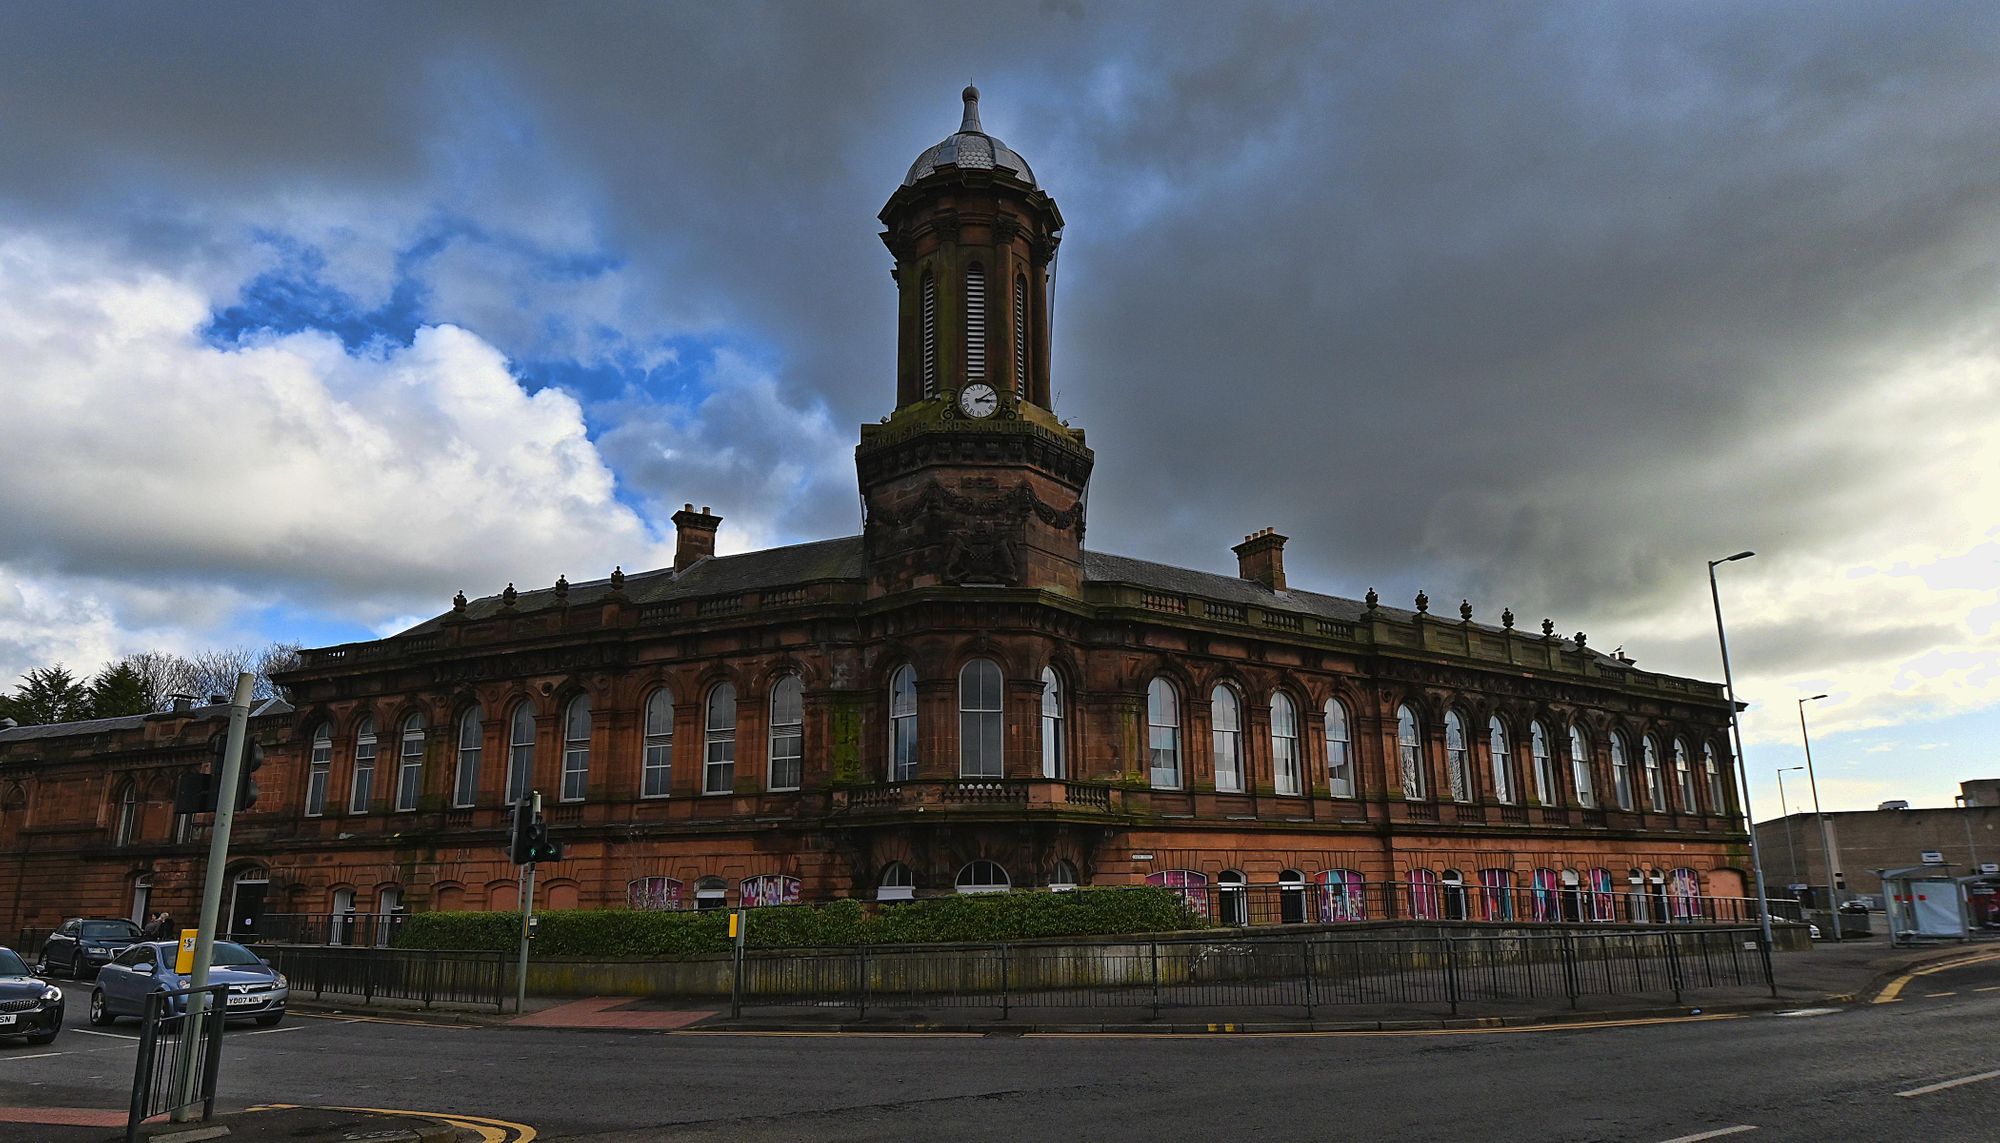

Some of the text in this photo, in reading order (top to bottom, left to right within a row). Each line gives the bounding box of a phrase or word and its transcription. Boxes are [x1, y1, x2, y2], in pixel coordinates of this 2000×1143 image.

[977, 421, 1002, 433] AND
[1007, 421, 1031, 433] THE
[743, 877, 801, 900] WHAT'S
